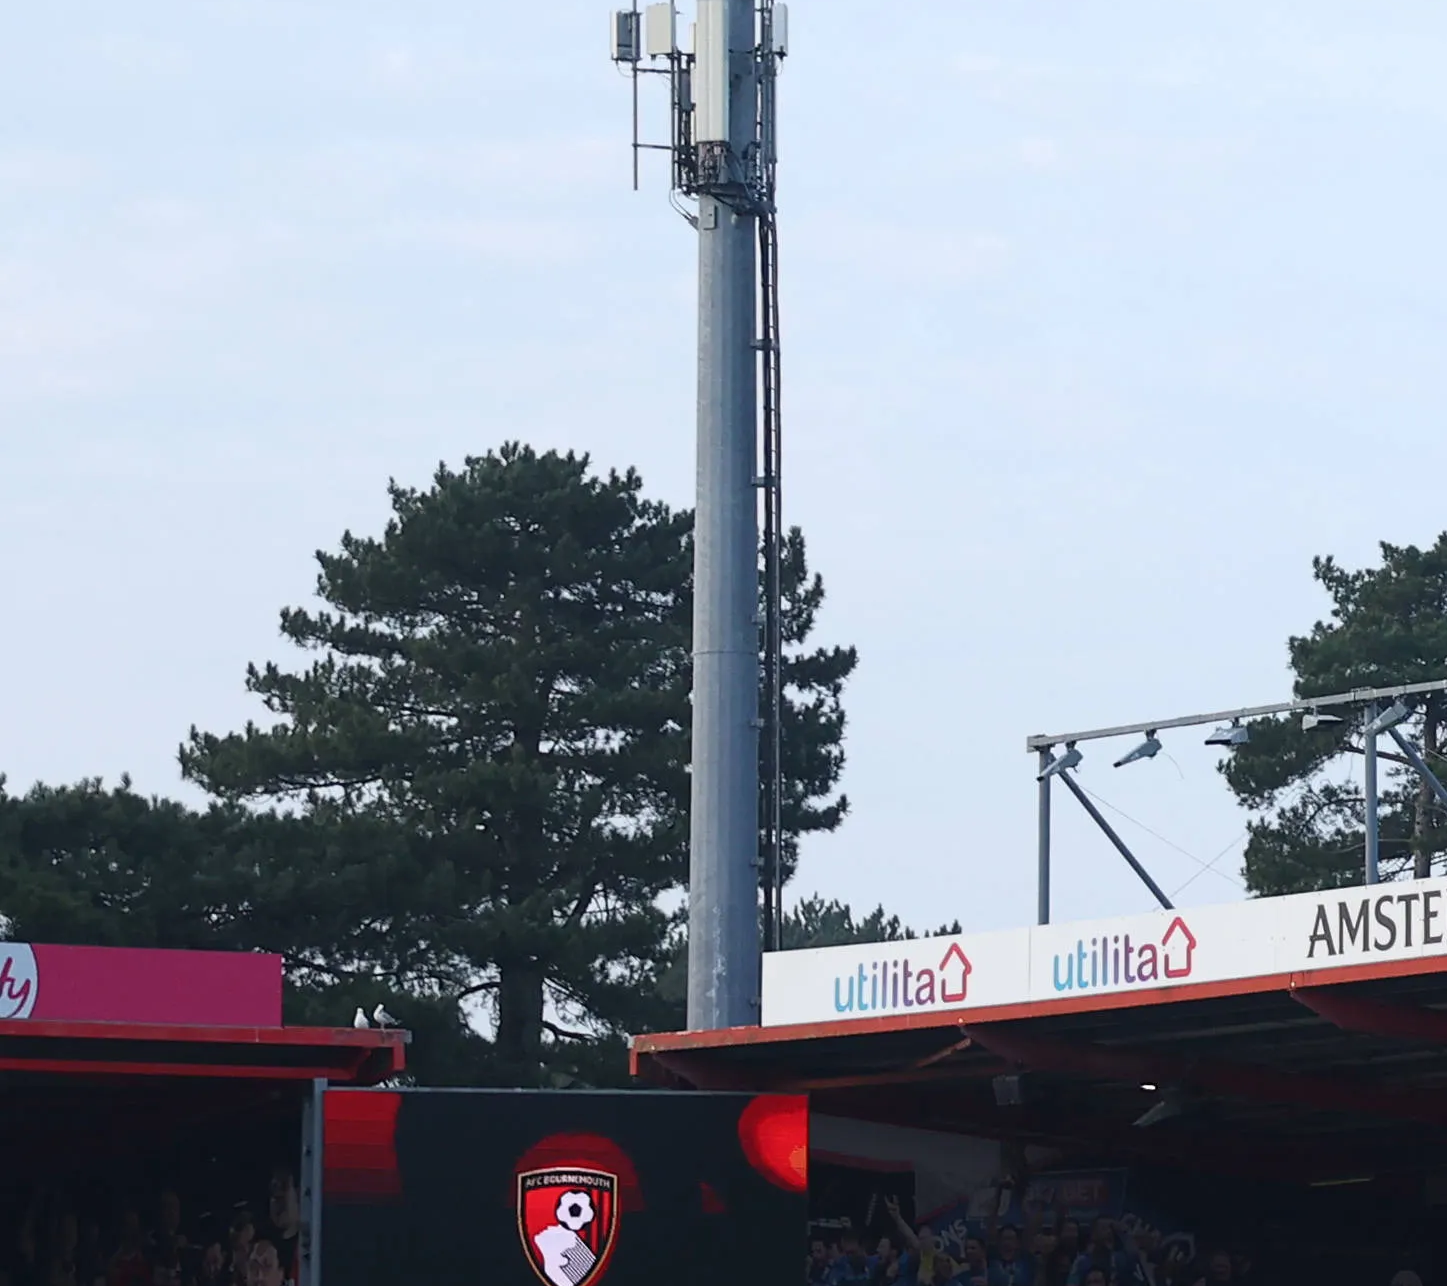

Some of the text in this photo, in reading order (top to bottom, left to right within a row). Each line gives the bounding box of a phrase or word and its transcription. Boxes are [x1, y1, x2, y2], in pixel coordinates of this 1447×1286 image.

[834, 959, 936, 1013] utilita
[1054, 934, 1159, 991] utilita
[544, 1174, 610, 1188] BOURNEMOUTH
